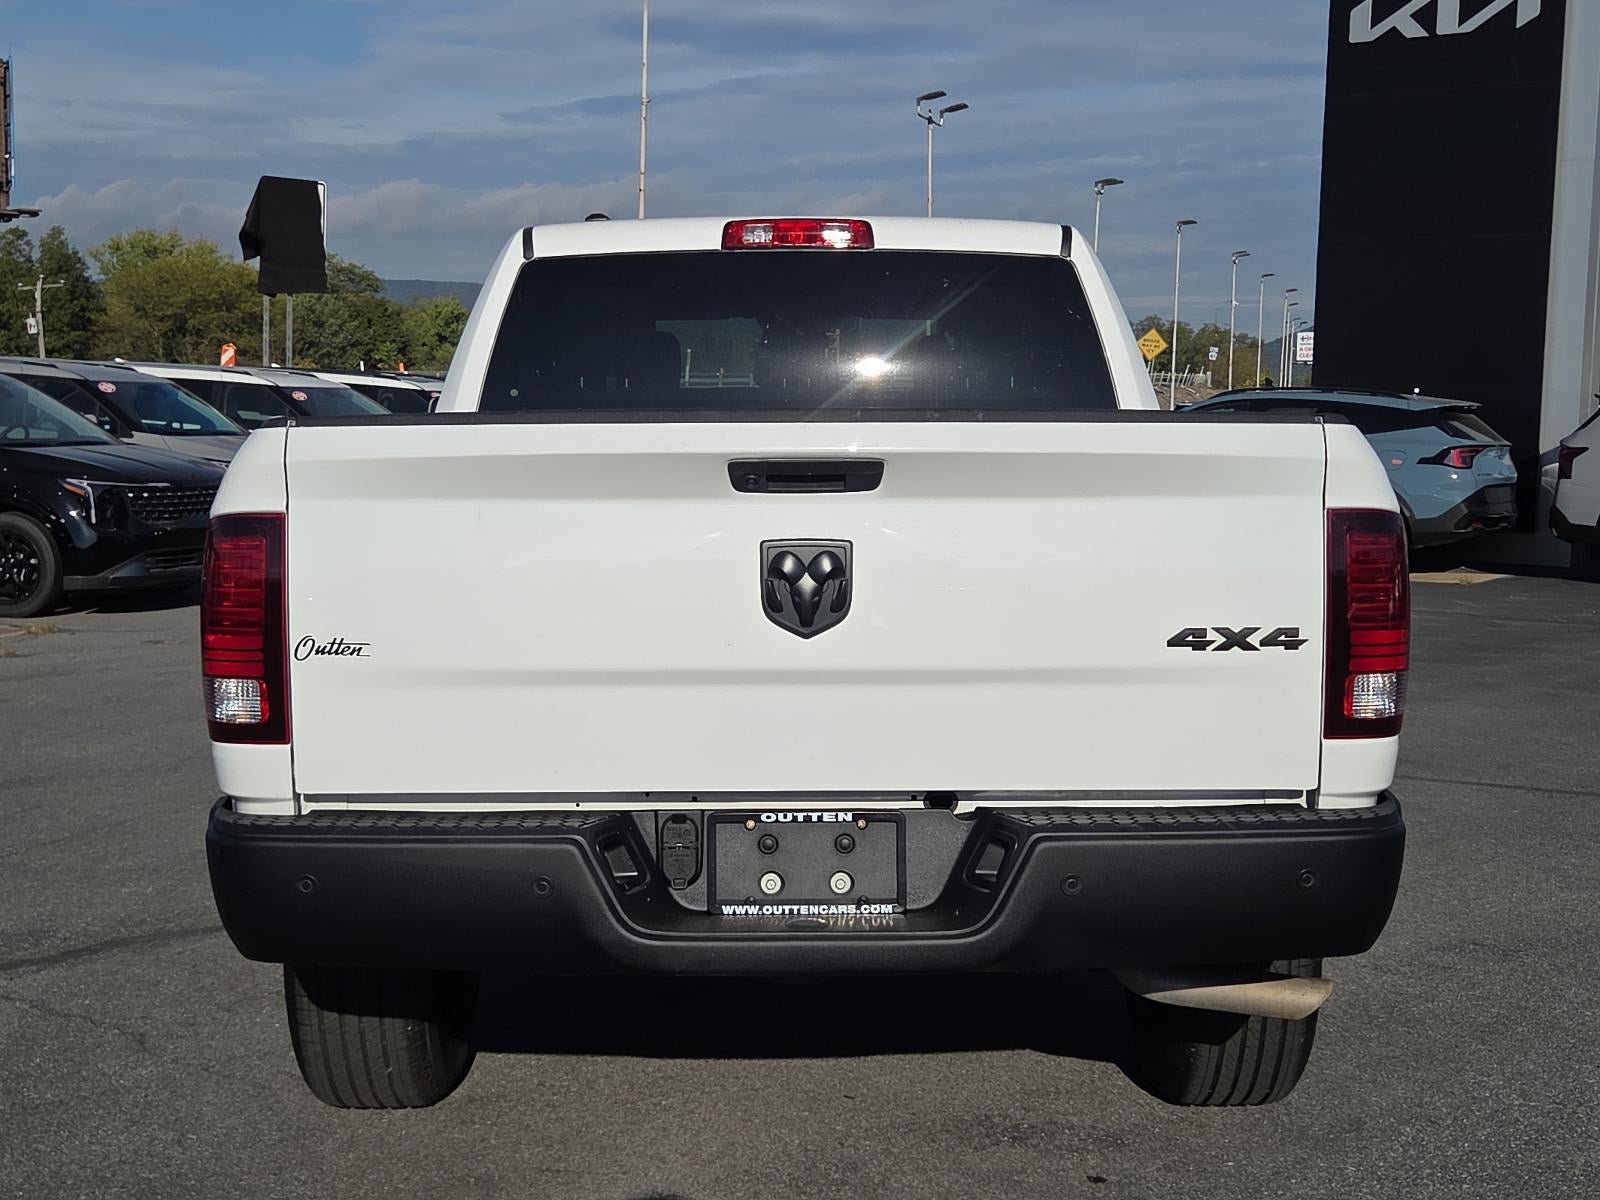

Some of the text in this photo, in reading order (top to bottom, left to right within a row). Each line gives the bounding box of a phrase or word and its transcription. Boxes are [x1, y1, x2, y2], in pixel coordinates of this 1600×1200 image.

[294, 635, 371, 661] Outten
[1166, 627, 1309, 652] 4X4
[760, 812, 853, 822] OUTTEN
[721, 904, 894, 915] WWW.OUTTENCARS.COM
